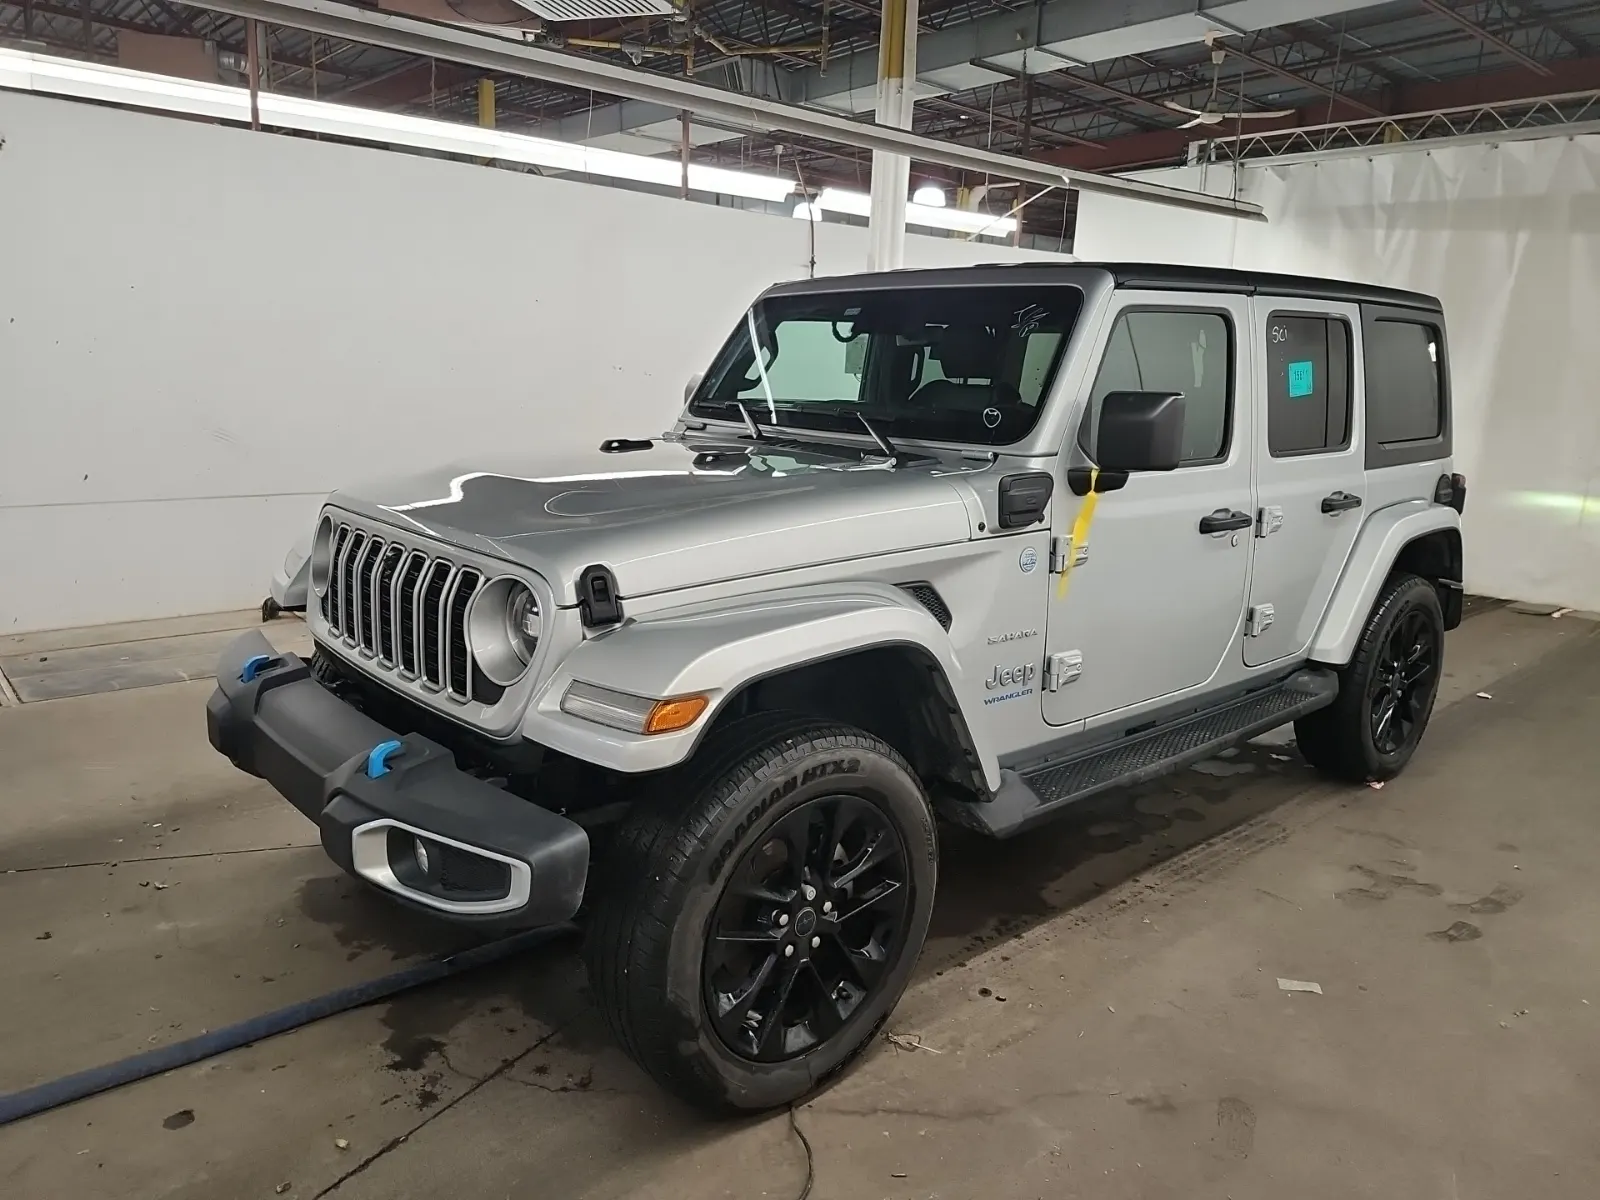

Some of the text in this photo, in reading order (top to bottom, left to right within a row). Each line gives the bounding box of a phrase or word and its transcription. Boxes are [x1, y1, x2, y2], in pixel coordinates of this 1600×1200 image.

[987, 628, 1038, 645] SAHARA
[985, 662, 1036, 690] Jeep
[983, 688, 1033, 706] WRANGLER
